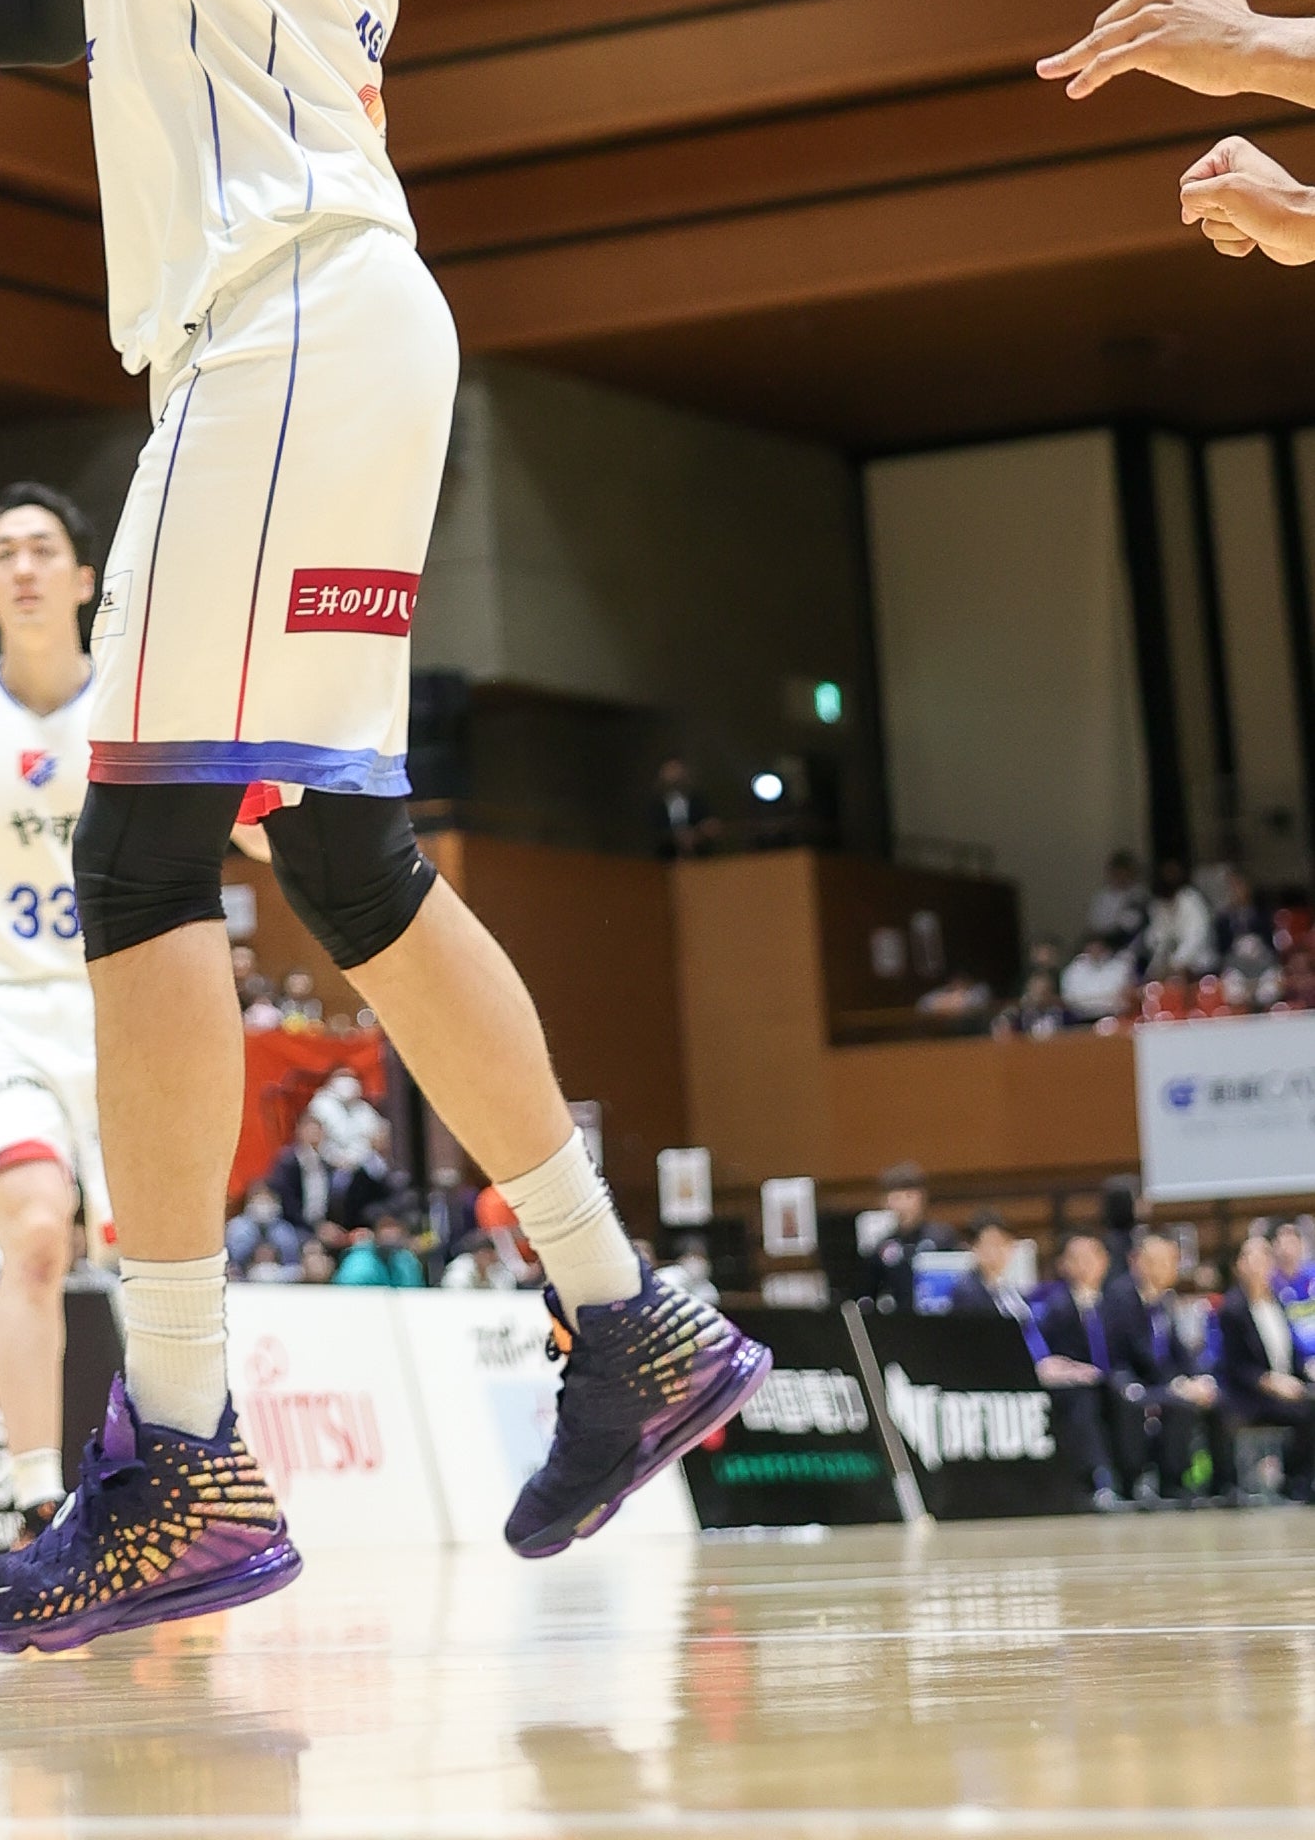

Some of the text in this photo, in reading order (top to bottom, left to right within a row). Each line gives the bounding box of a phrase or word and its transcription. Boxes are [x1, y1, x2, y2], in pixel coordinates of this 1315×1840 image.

[294, 586, 417, 620] 三井のリハ
[12, 812, 78, 847] やず
[11, 884, 79, 938] 33
